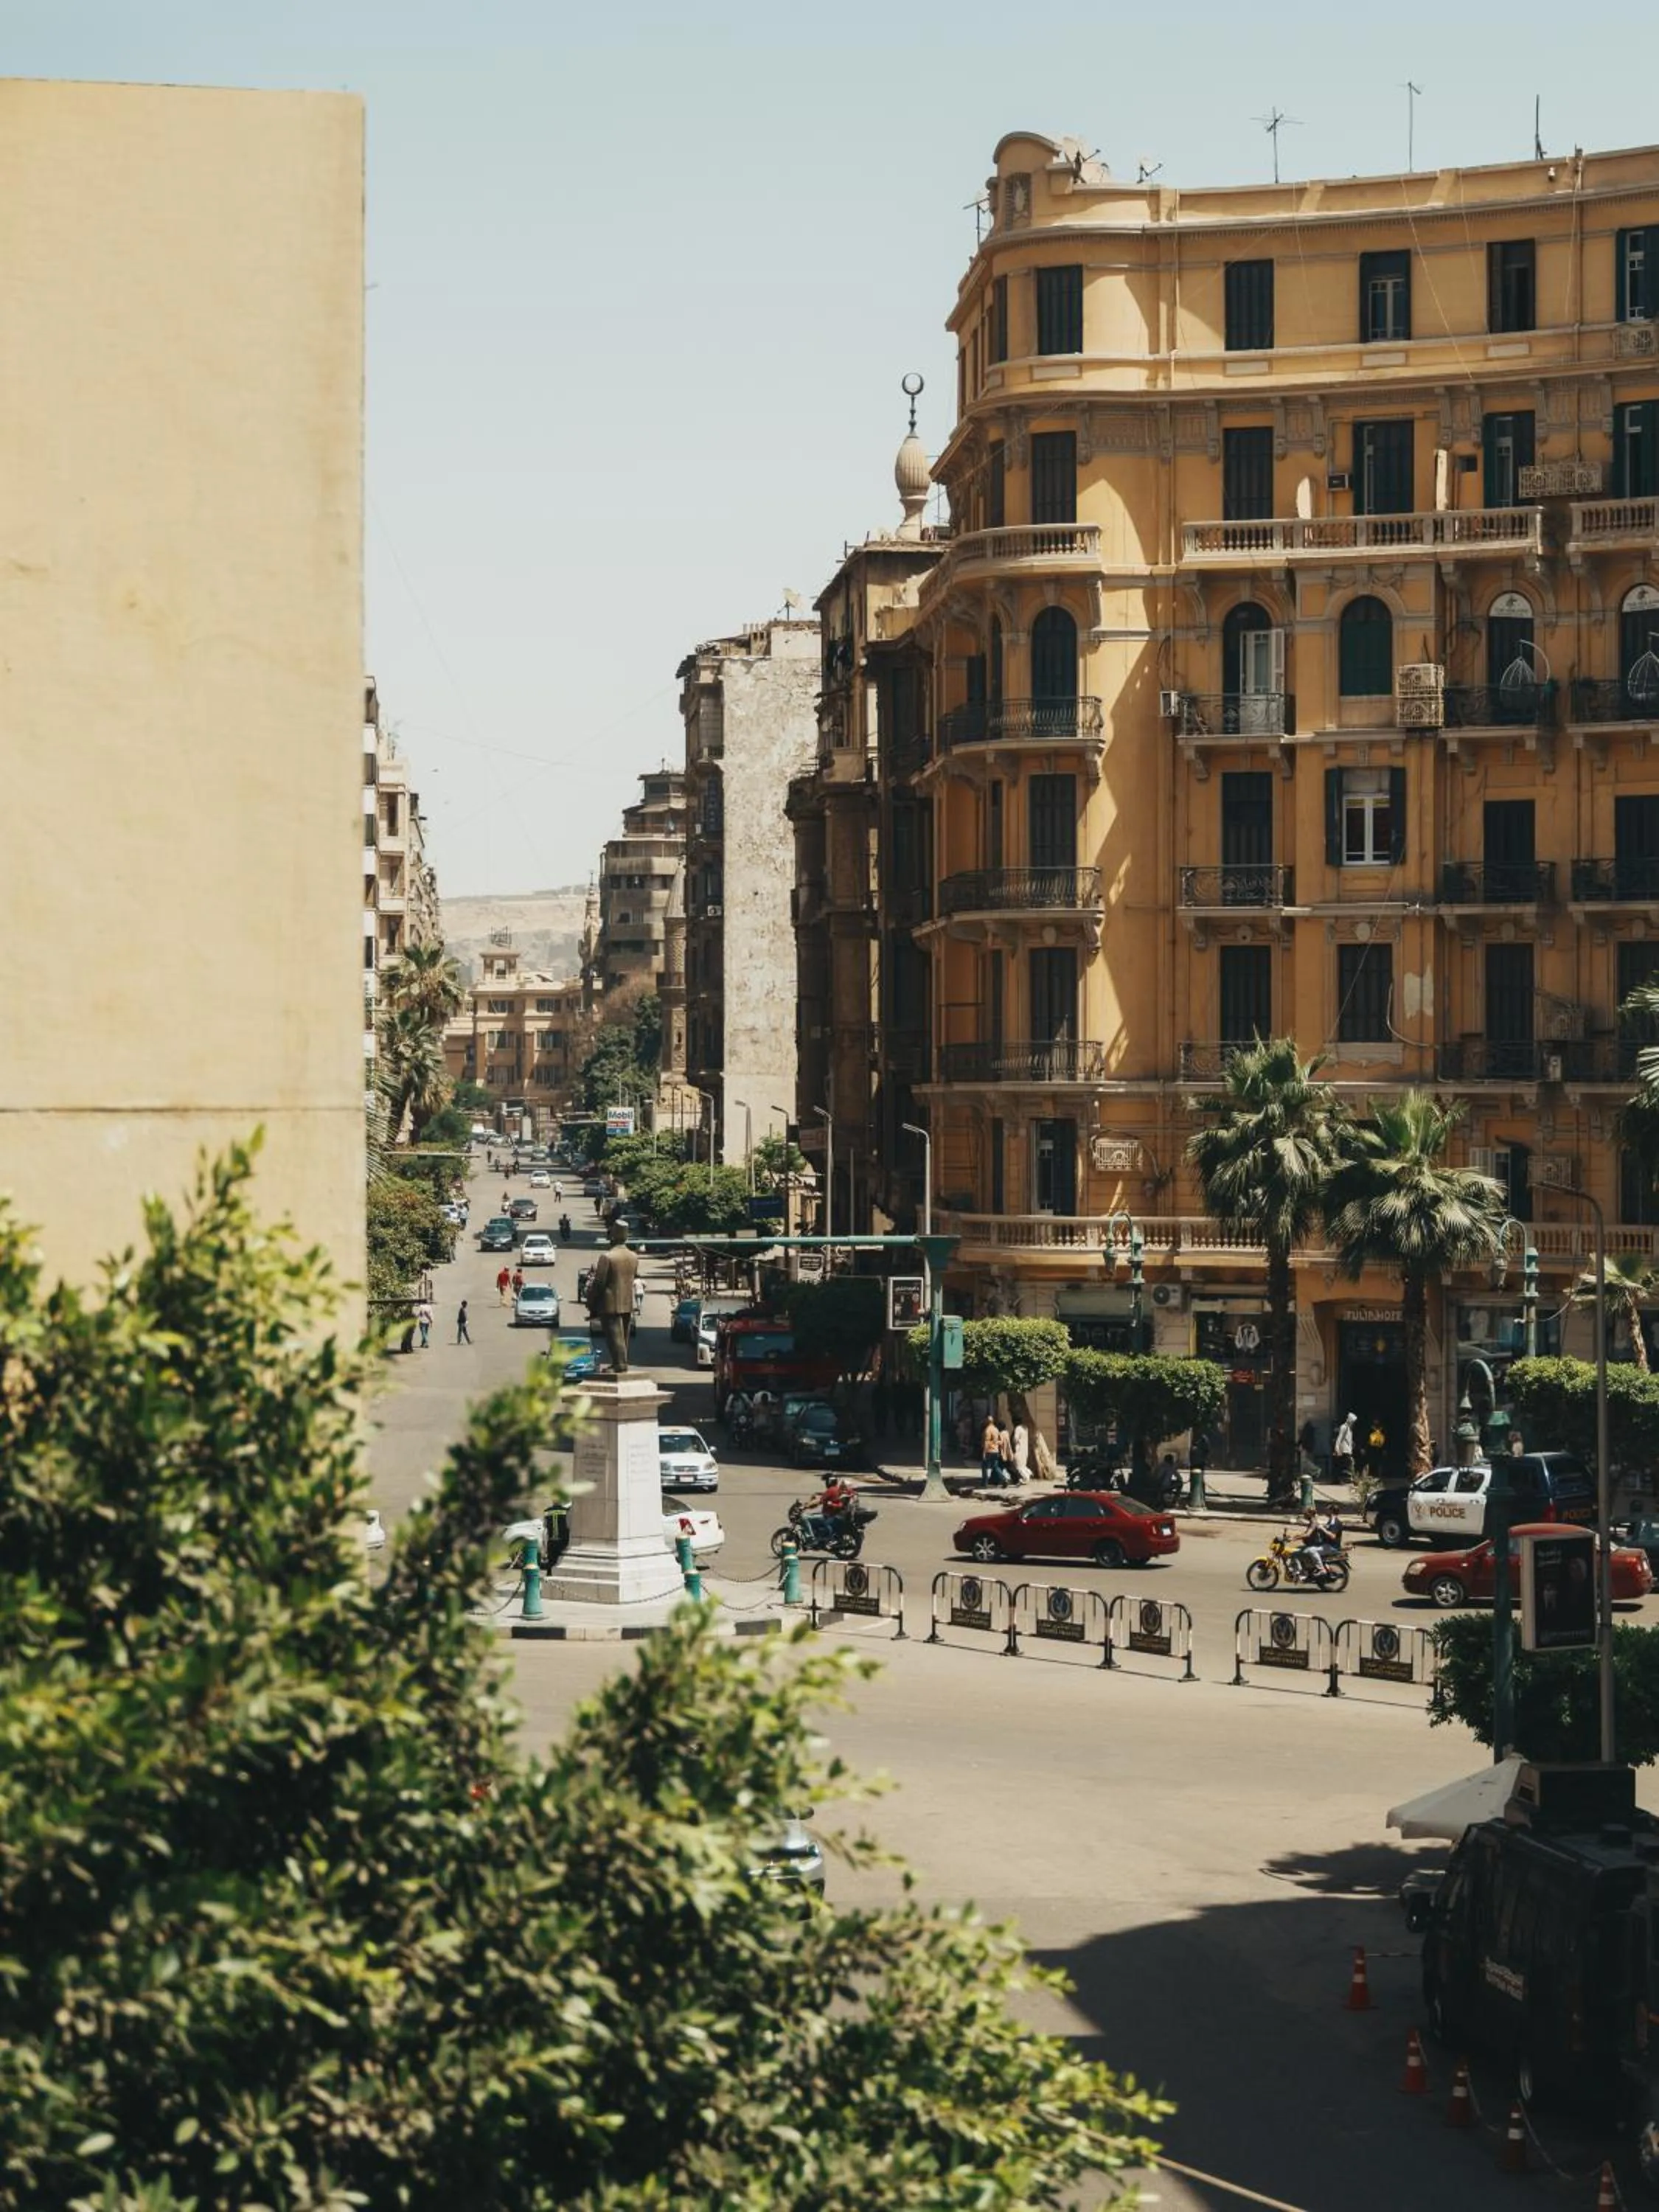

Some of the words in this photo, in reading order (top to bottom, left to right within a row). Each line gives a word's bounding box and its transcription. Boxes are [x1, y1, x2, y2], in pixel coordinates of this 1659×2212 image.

[608, 1111, 633, 1119] Mobil
[1376, 1310, 1404, 1321] HOTE
[1430, 1506, 1466, 1519] POLICE
